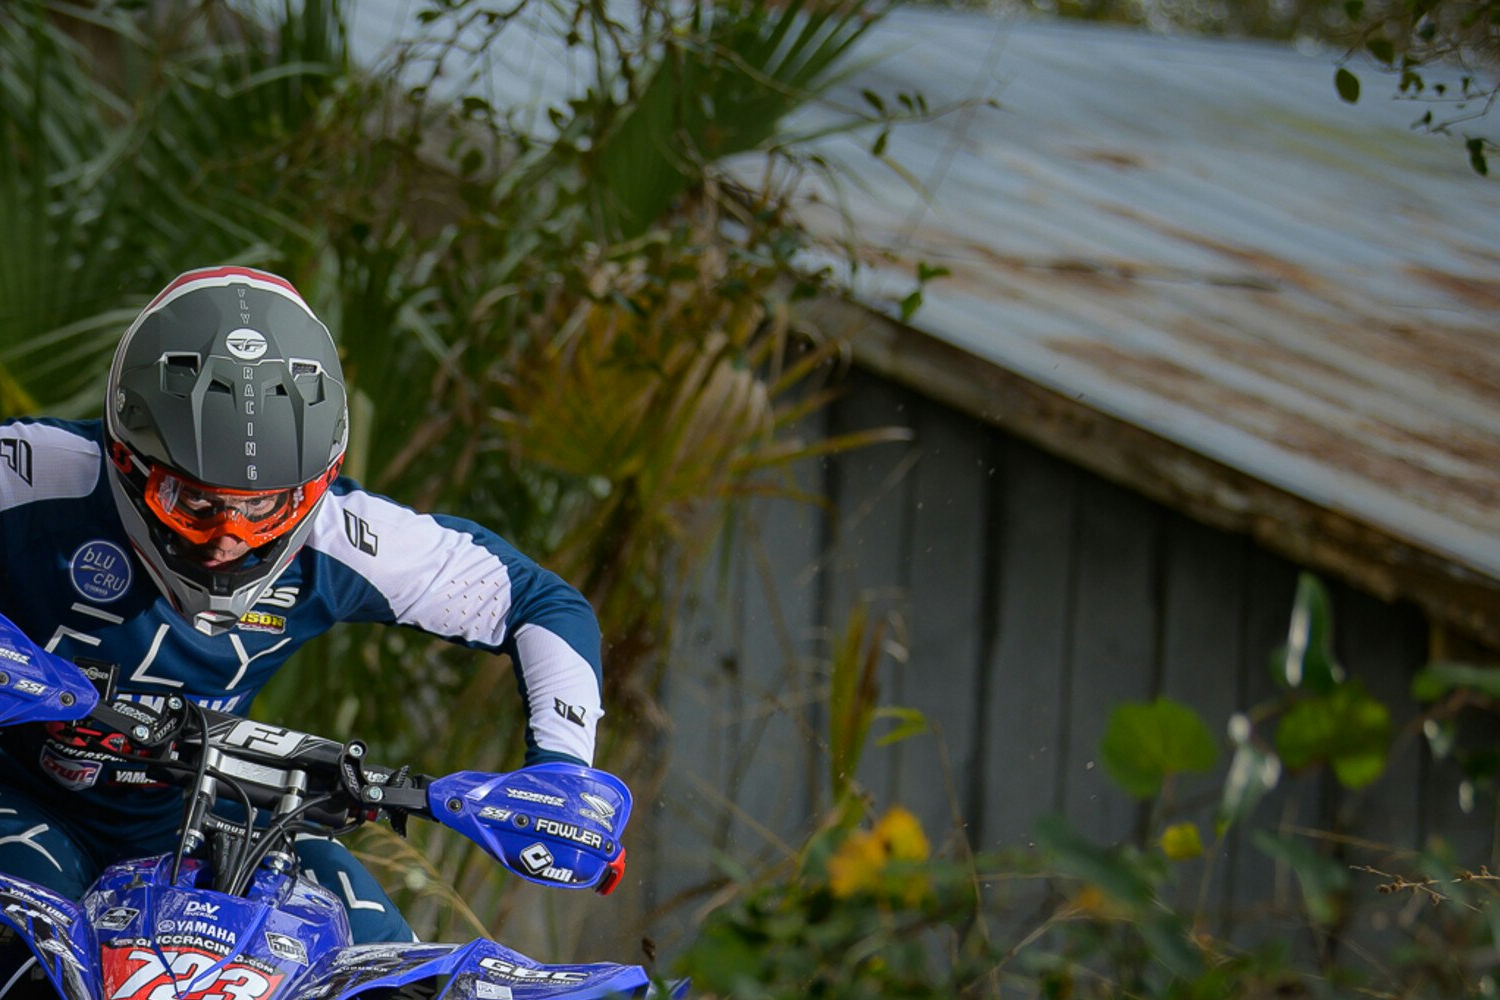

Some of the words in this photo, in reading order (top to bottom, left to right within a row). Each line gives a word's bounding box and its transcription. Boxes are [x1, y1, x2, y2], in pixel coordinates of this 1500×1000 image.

[243, 366, 258, 481] RACING
[535, 817, 603, 849] FOWLER
[177, 920, 237, 944] YAMAHA
[479, 956, 591, 982] GBC
